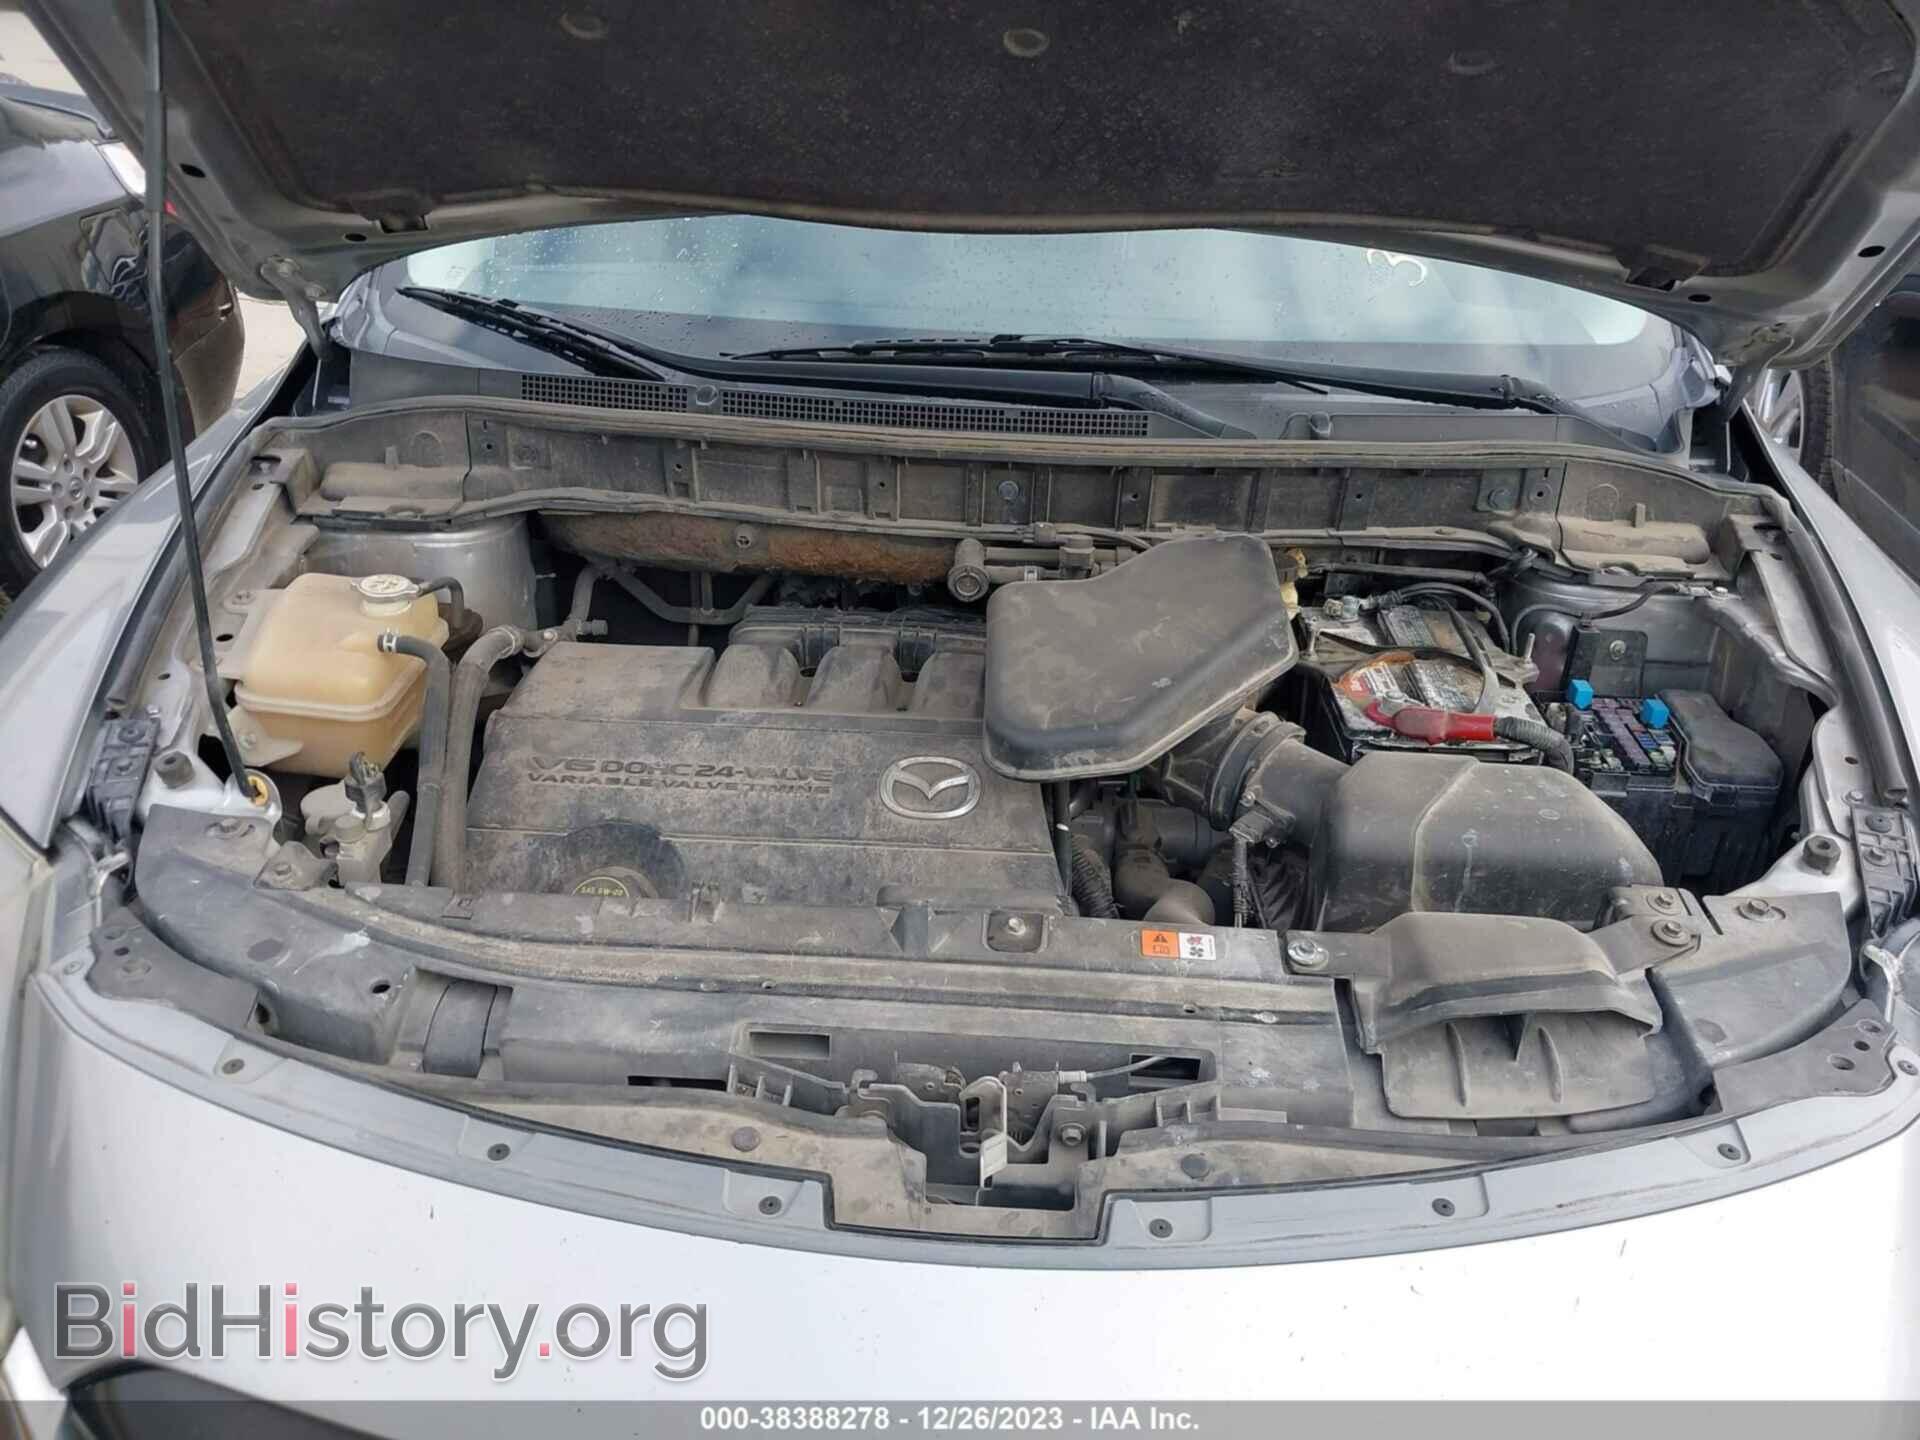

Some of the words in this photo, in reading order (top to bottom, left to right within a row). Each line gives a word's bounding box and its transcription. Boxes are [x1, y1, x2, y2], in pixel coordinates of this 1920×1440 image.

[533, 756, 596, 772] V6
[601, 760, 692, 776] DOHC
[528, 773, 652, 787] VARIABLE
[662, 778, 738, 791] VALVE
